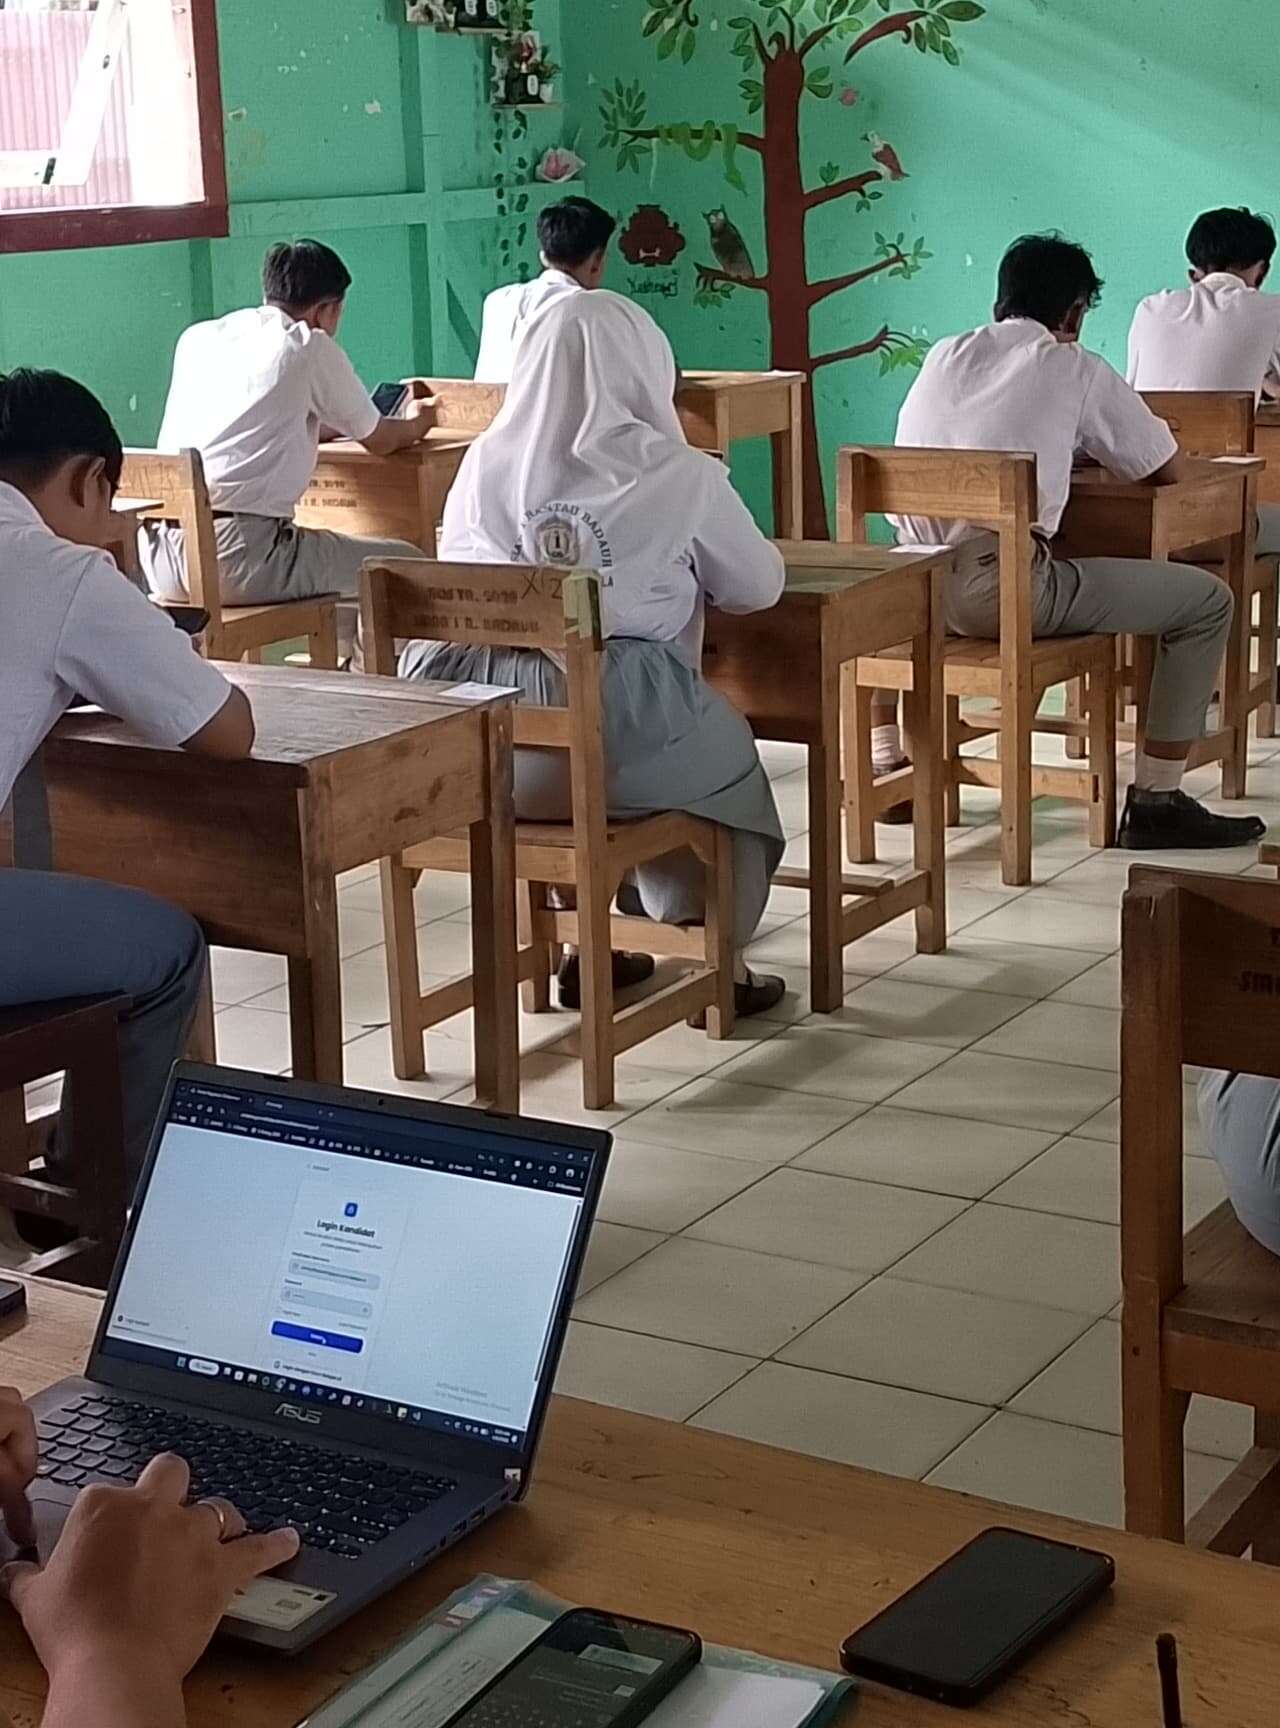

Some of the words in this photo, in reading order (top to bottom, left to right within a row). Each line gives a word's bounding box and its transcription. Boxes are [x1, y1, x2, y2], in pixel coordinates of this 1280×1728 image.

[581, 512, 613, 567] BADAUH
[317, 1220, 338, 1231] Login
[340, 1225, 376, 1238] Kandidat
[274, 1403, 323, 1424] ASUS
